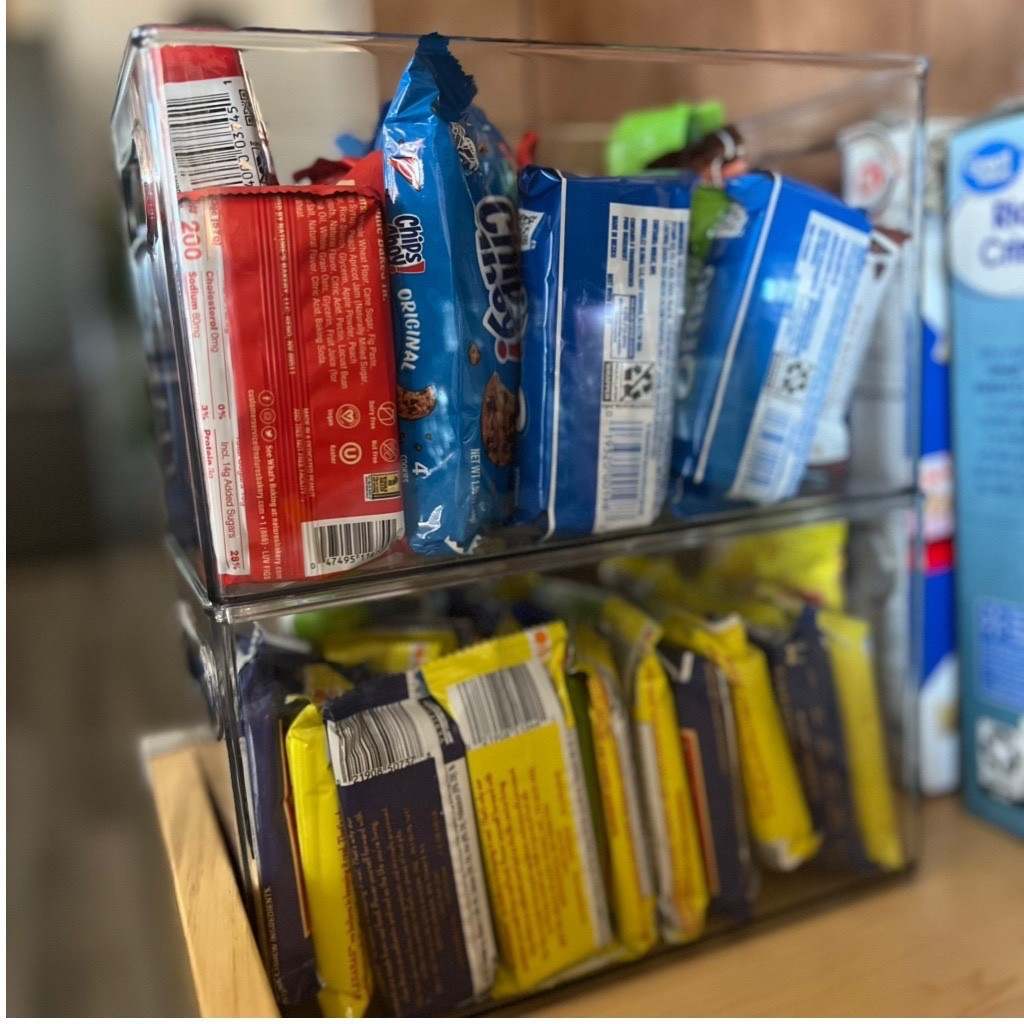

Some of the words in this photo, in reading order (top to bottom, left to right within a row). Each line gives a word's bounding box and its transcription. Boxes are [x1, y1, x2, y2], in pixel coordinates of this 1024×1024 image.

[180, 221, 203, 260] 200
[358, 239, 368, 263] Wheat
[394, 214, 421, 265] Chips
[188, 271, 199, 310] Sodium
[206, 270, 218, 331] Cholesterol
[342, 286, 351, 308] Apple
[363, 287, 373, 307] Cane
[191, 312, 201, 338] 80mg
[345, 310, 354, 340] Powder,
[366, 308, 375, 332] Sugar,
[397, 288, 421, 371] ORIGINAL
[210, 332, 219, 353] 0mg
[353, 282, 362, 299] Jam
[360, 361, 369, 385] Sugar,
[367, 334, 376, 346] Fig
[338, 344, 347, 370] Locust
[201, 404, 210, 420] 3%
[217, 404, 226, 419] 0%
[203, 429, 214, 466] Protein
[266, 445, 274, 457] See
[470, 448, 480, 463] NET
[221, 460, 232, 478] 14g
[267, 459, 276, 482] What's
[412, 462, 430, 478] 4
[471, 465, 481, 478] WT
[224, 479, 233, 504] Added
[225, 507, 236, 539] Sugars
[230, 550, 241, 570] 28%
[262, 551, 270, 564] LUV
[262, 565, 271, 580] FIGS
[264, 887, 277, 942] INGREDIENTS
